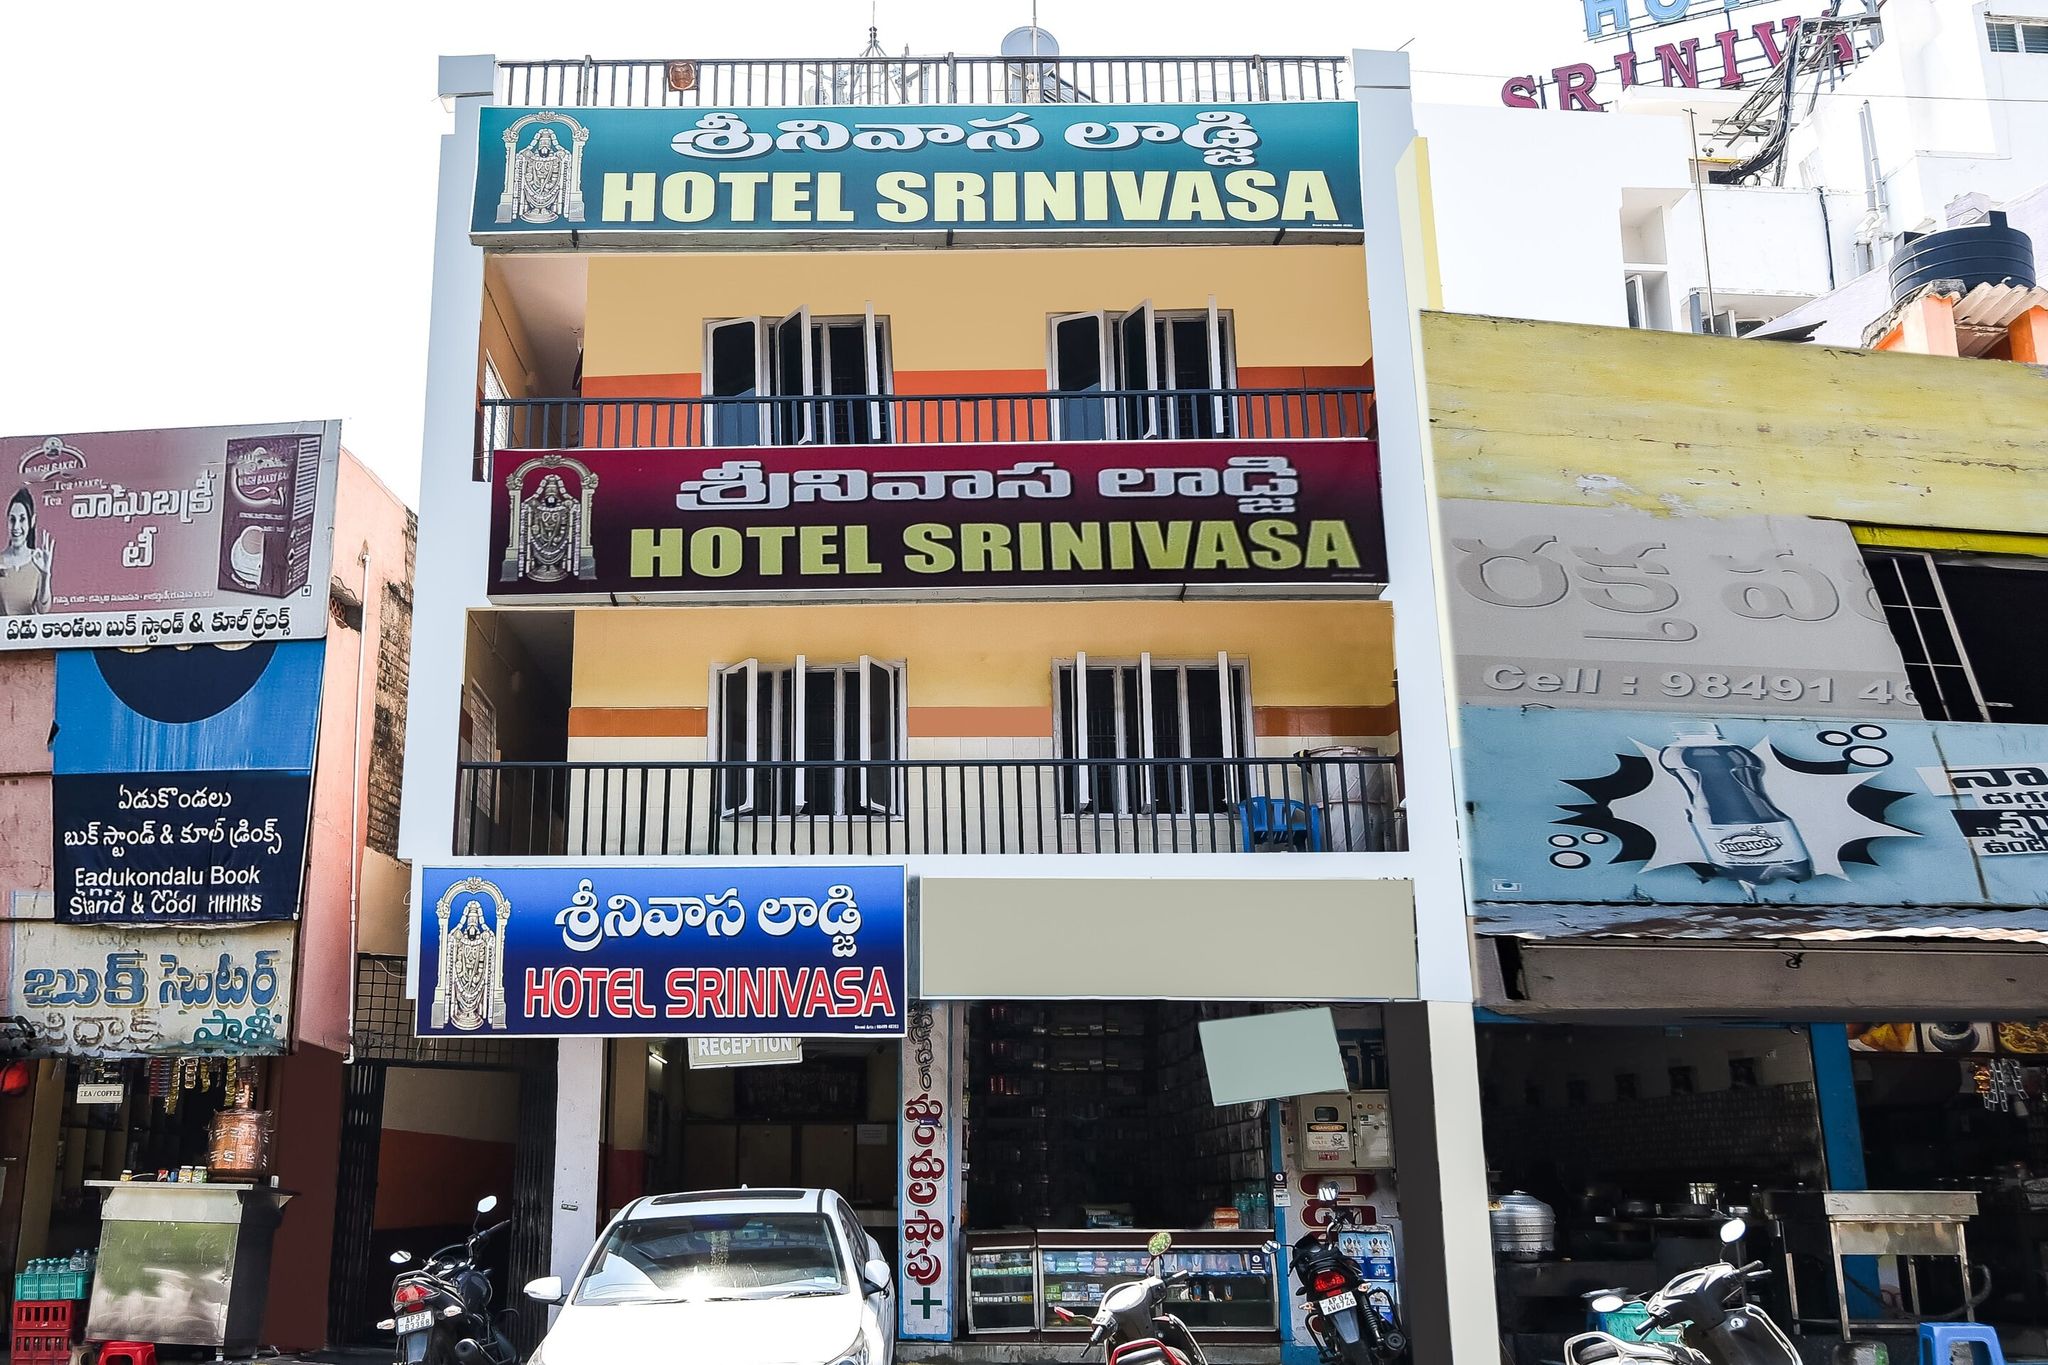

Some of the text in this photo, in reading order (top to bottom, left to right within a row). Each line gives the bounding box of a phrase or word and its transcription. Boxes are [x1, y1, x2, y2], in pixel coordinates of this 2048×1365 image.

[671, 111, 1258, 165] శ్రీనివాస లాడ్జి
[602, 169, 1340, 223] HOTEL SRINIVASA
[676, 456, 1298, 514] శ్రీనివాస లాడ్జి
[630, 520, 1360, 577] HOTEL SRINIVASA
[189, 612, 204, 633] &
[1484, 664, 1600, 694] Cell
[1661, 671, 1833, 701] 98491
[118, 784, 232, 809] ఏడుకొండలు
[160, 824, 174, 844] &
[75, 864, 260, 887] Eadukondalu Book
[554, 878, 862, 958] శ్రీనివాస లాడ్జి
[524, 966, 897, 1018] HOTEL SRINIVASA
[699, 1038, 792, 1056] RECEPTION
